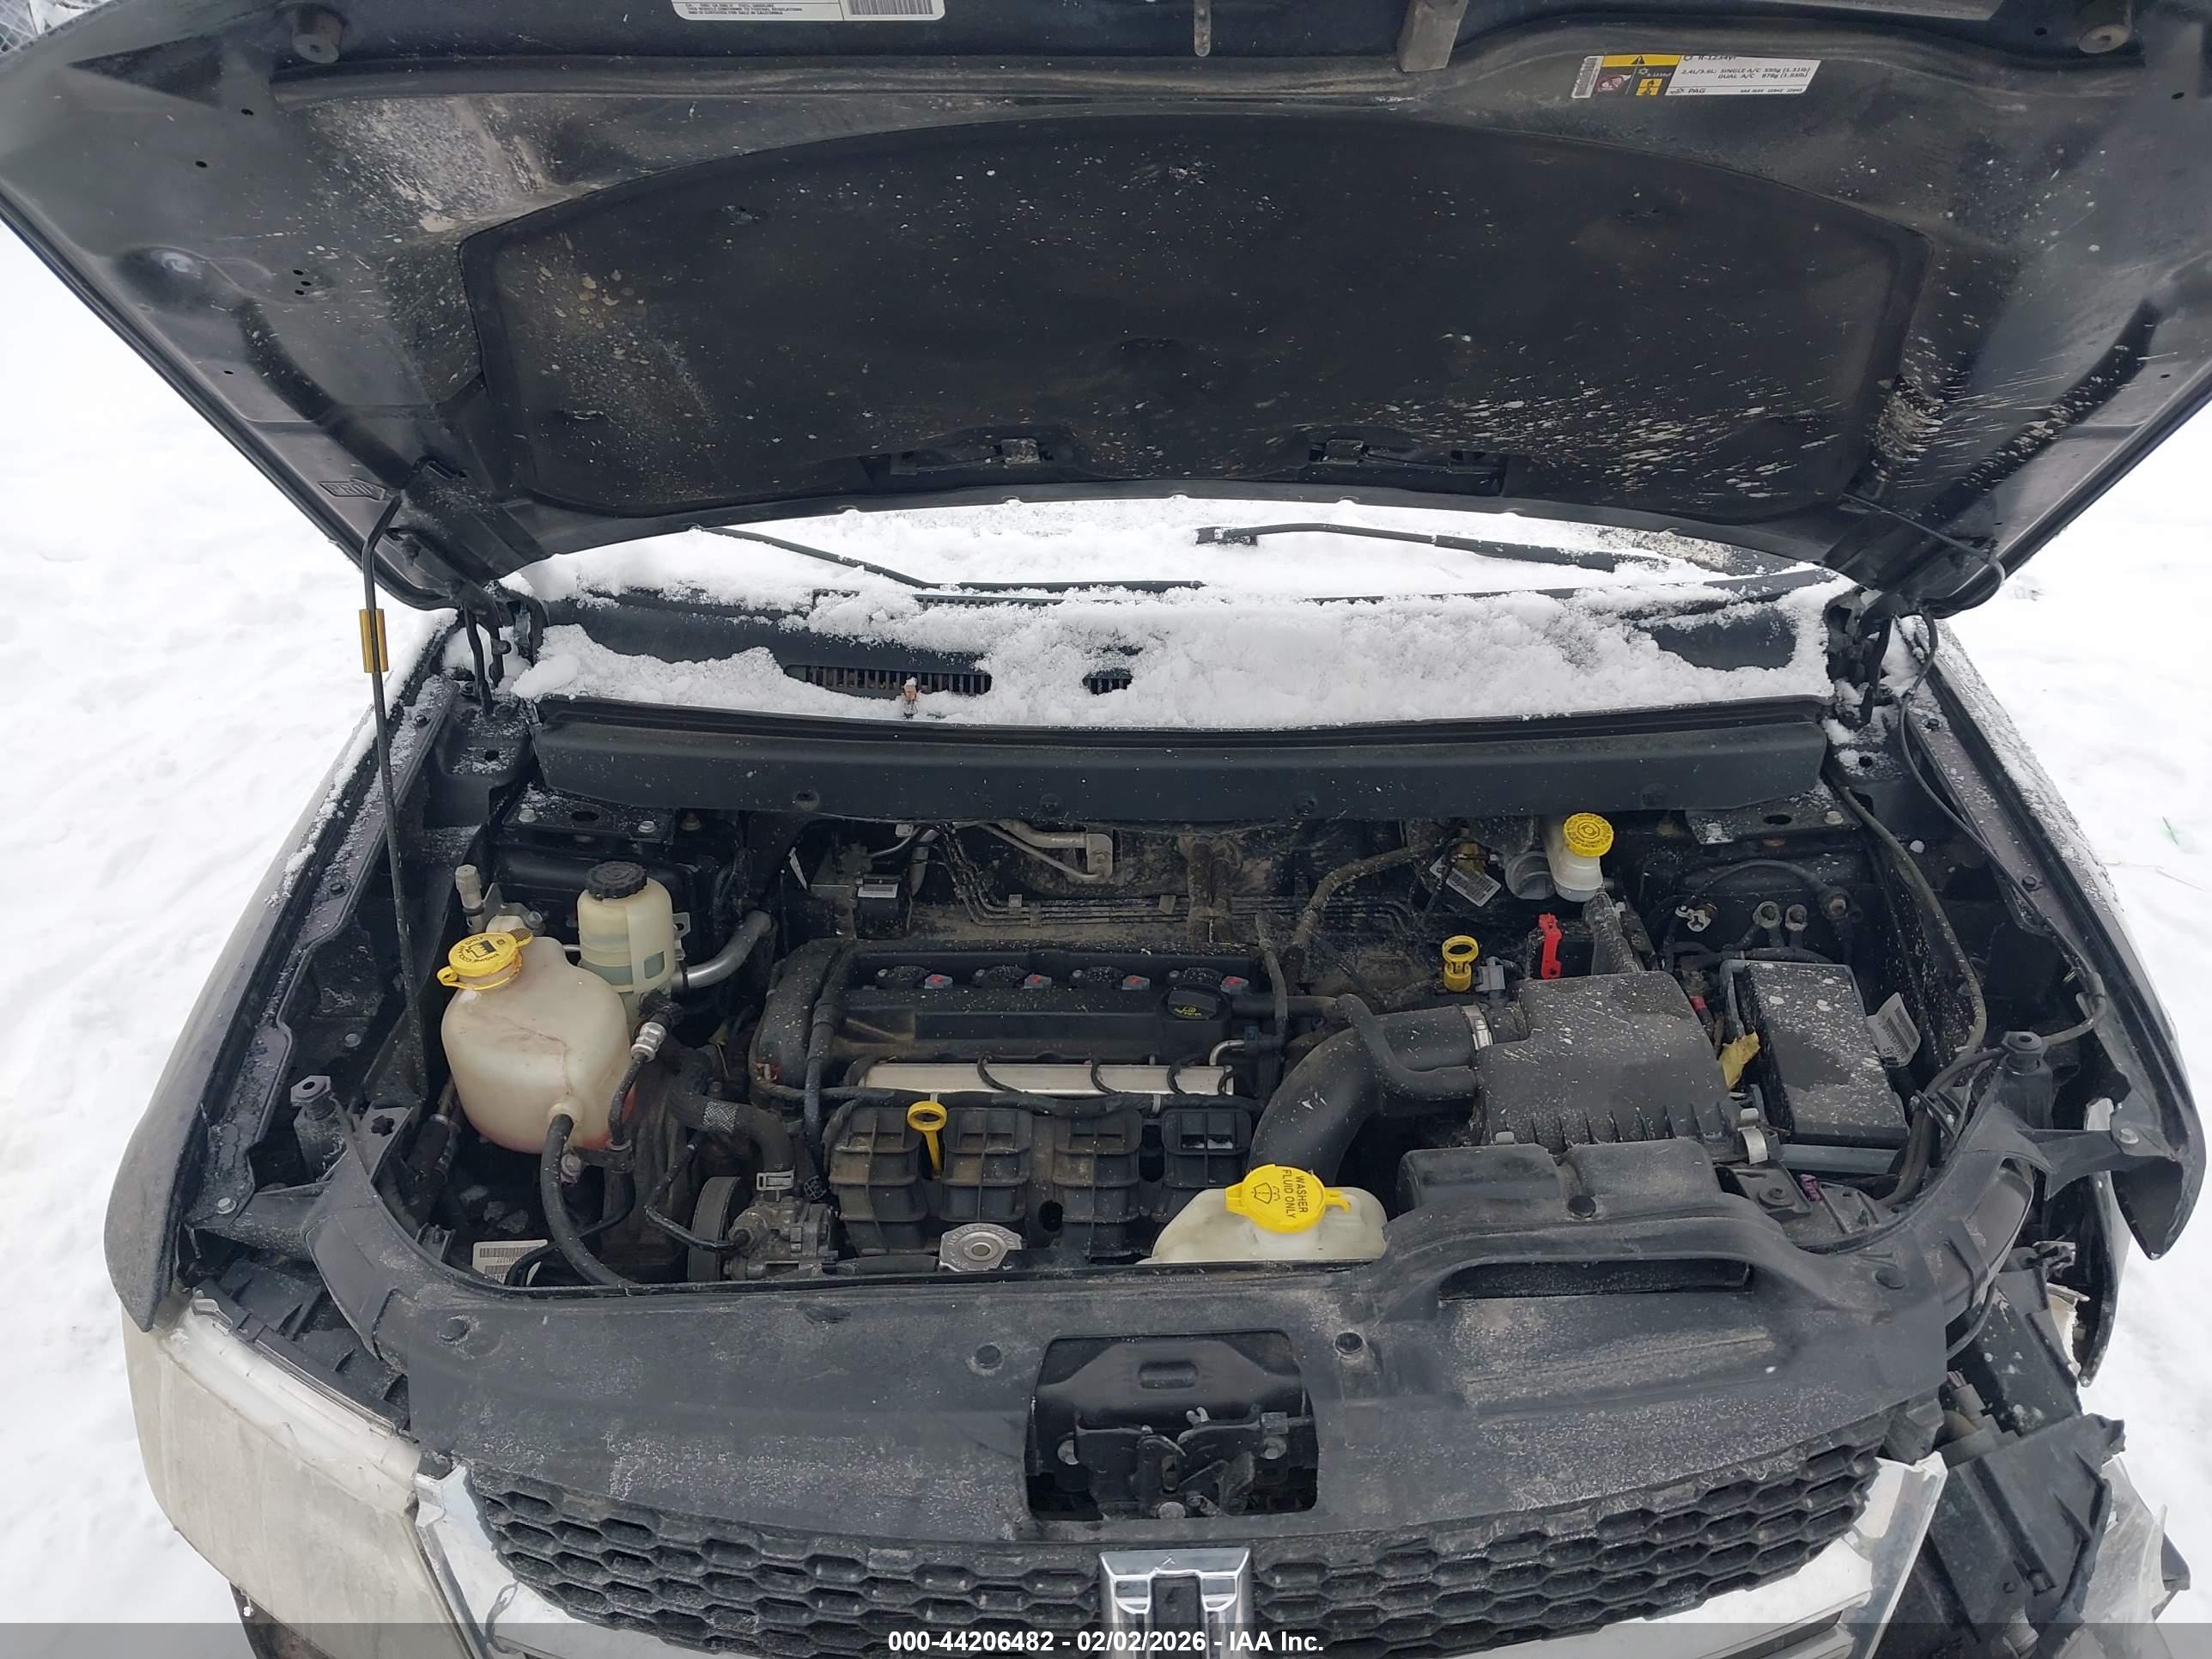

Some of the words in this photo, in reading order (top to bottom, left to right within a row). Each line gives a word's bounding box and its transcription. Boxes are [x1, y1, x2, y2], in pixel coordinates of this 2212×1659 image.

[1282, 1169, 1293, 1194] FLUID
[1295, 1175, 1309, 1213] WASHER
[1285, 1195, 1297, 1219] ONLY
